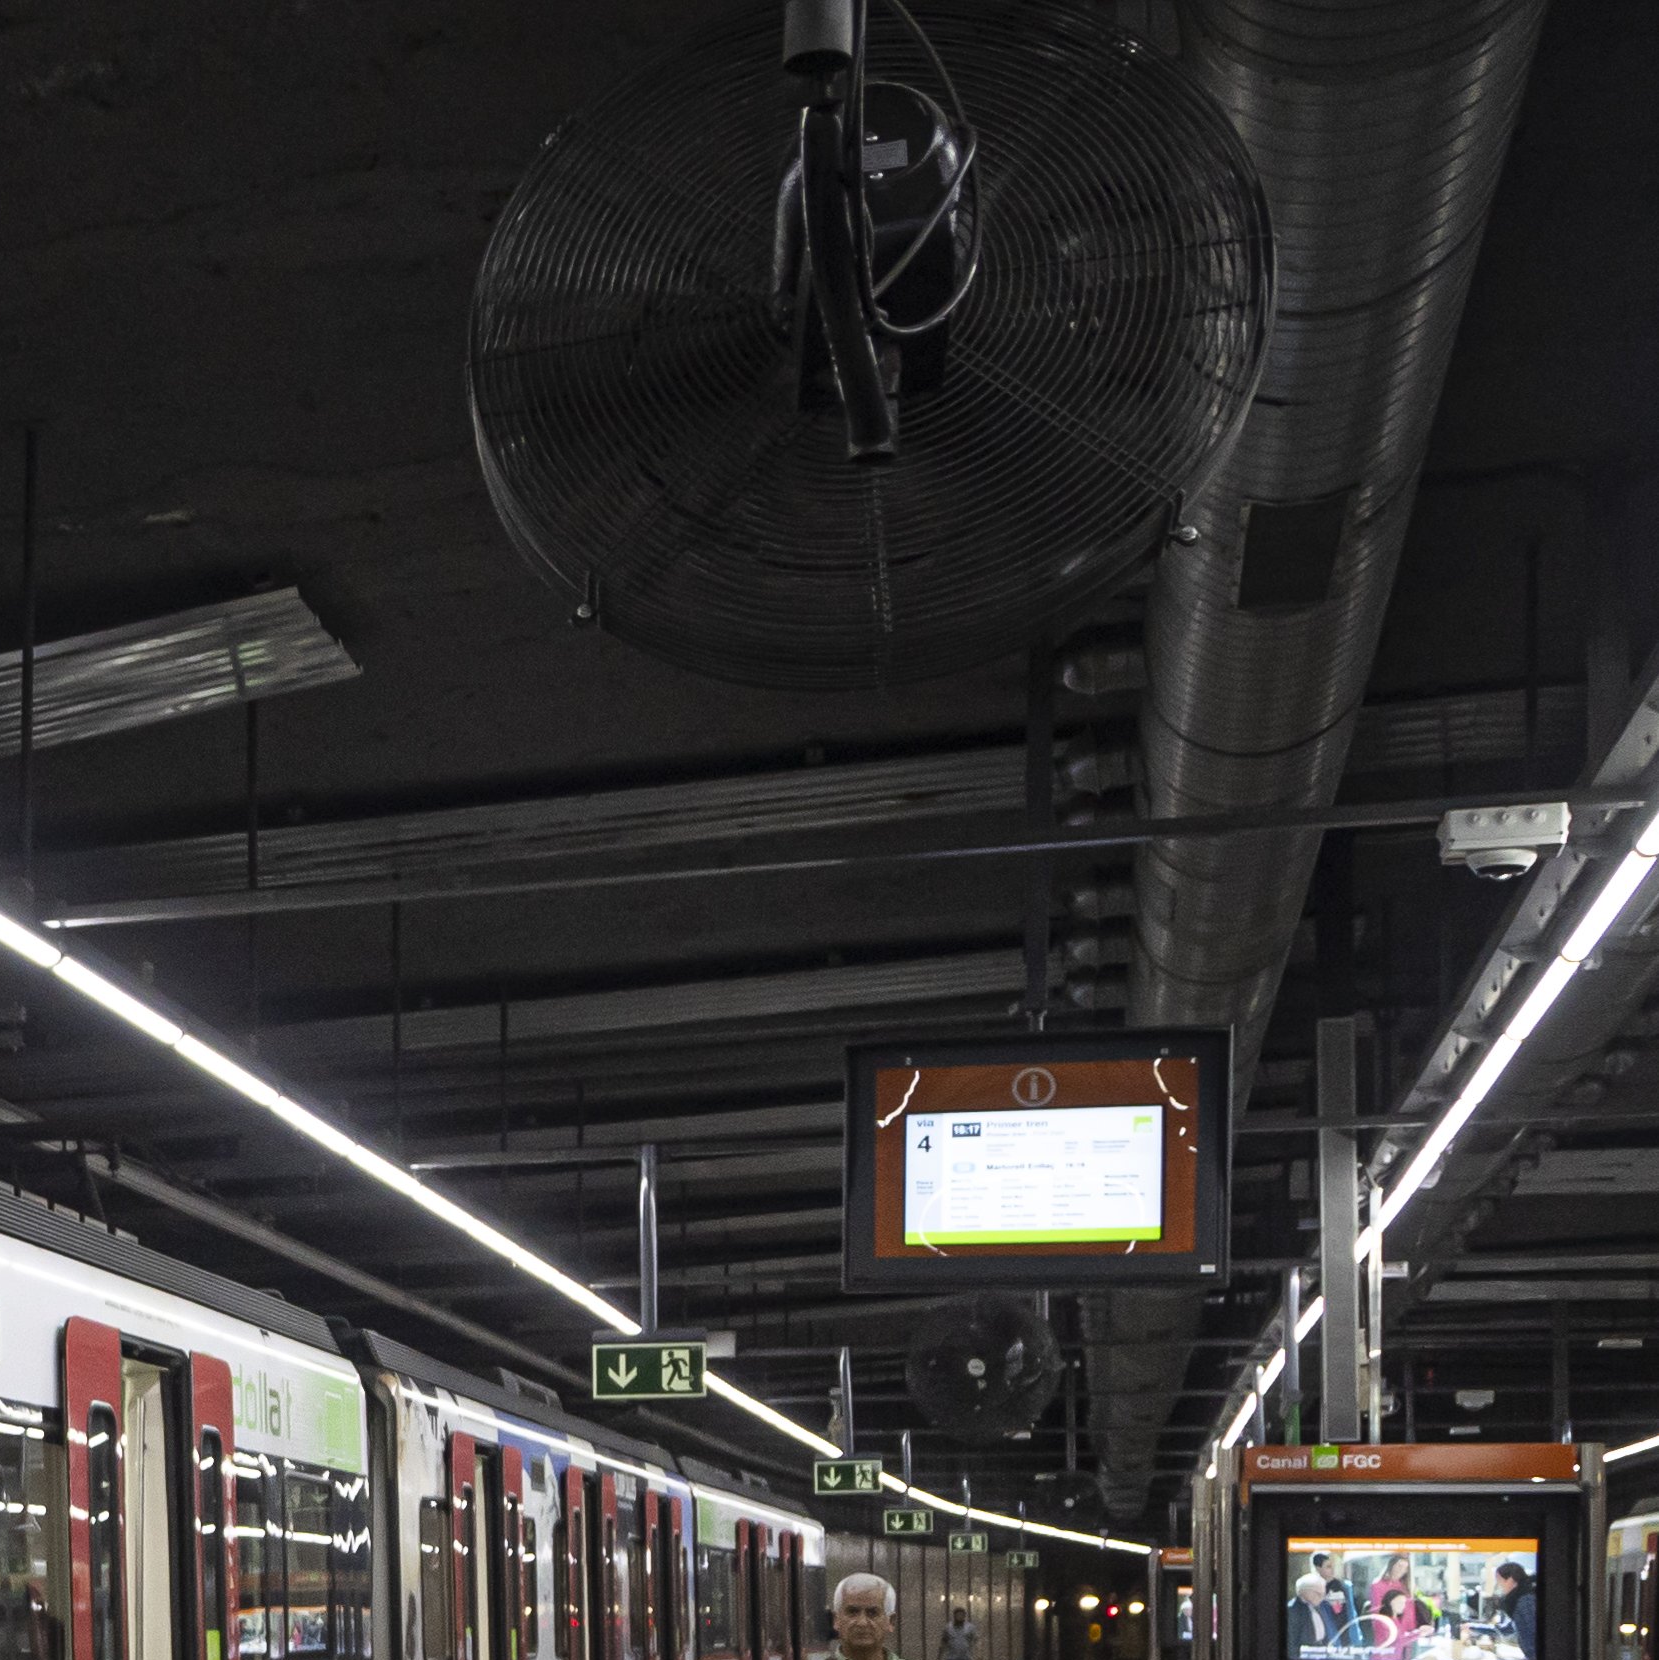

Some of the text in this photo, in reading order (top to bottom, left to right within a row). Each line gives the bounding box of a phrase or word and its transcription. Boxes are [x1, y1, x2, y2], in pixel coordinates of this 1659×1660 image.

[916, 1118, 935, 1129] via
[1026, 1119, 1049, 1129] tren
[917, 1135, 932, 1153] 4
[1256, 1454, 1381, 1470] Canal FGC
